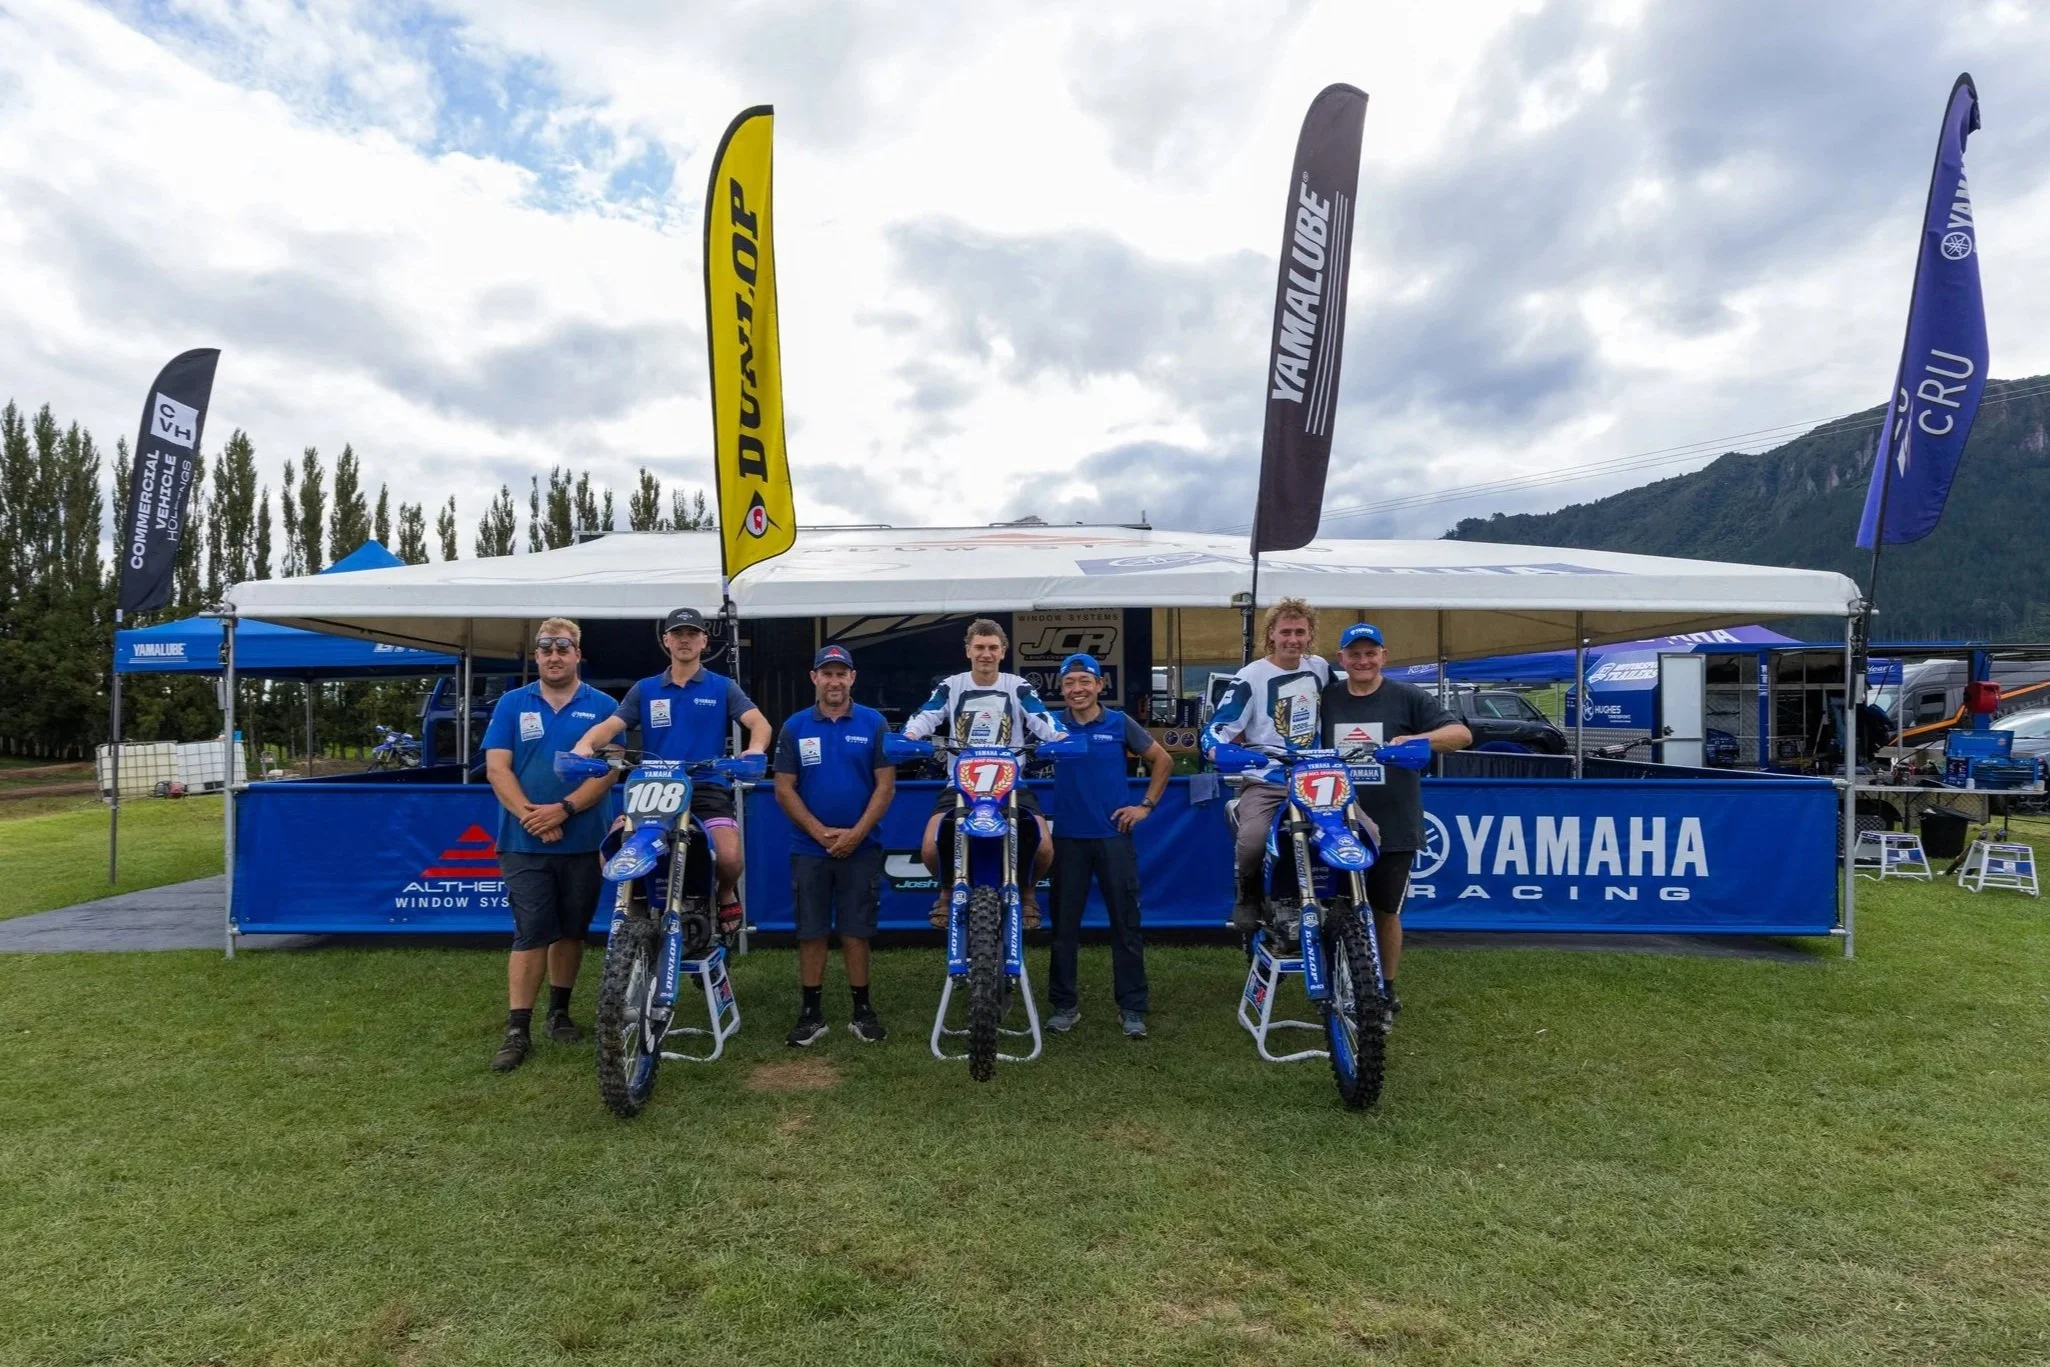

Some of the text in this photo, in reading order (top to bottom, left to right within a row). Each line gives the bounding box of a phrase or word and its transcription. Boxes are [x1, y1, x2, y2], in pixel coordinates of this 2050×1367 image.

[1272, 182, 1330, 403] YAMALUBE
[729, 177, 768, 483] DUNLOP
[1917, 349, 1974, 435] CRU
[155, 454, 177, 529] VEHICLE
[130, 449, 160, 570] COMMERCIAL
[1018, 612, 1119, 622] WINDOW SYSTEMS
[133, 643, 184, 656] YAMALUBE
[1018, 626, 1118, 656] JCR
[1595, 705, 1622, 714] HUGHES
[973, 764, 1000, 792] 1
[1311, 776, 1335, 806] 1
[626, 782, 686, 814] 108
[1456, 815, 1709, 877] YAMAHA
[895, 879, 939, 888] Josh
[1407, 884, 1691, 901] RACING
[395, 897, 510, 908] WINDOW SYS
[666, 938, 676, 991] DUNLOP
[1305, 930, 1319, 983] DUNLOP
